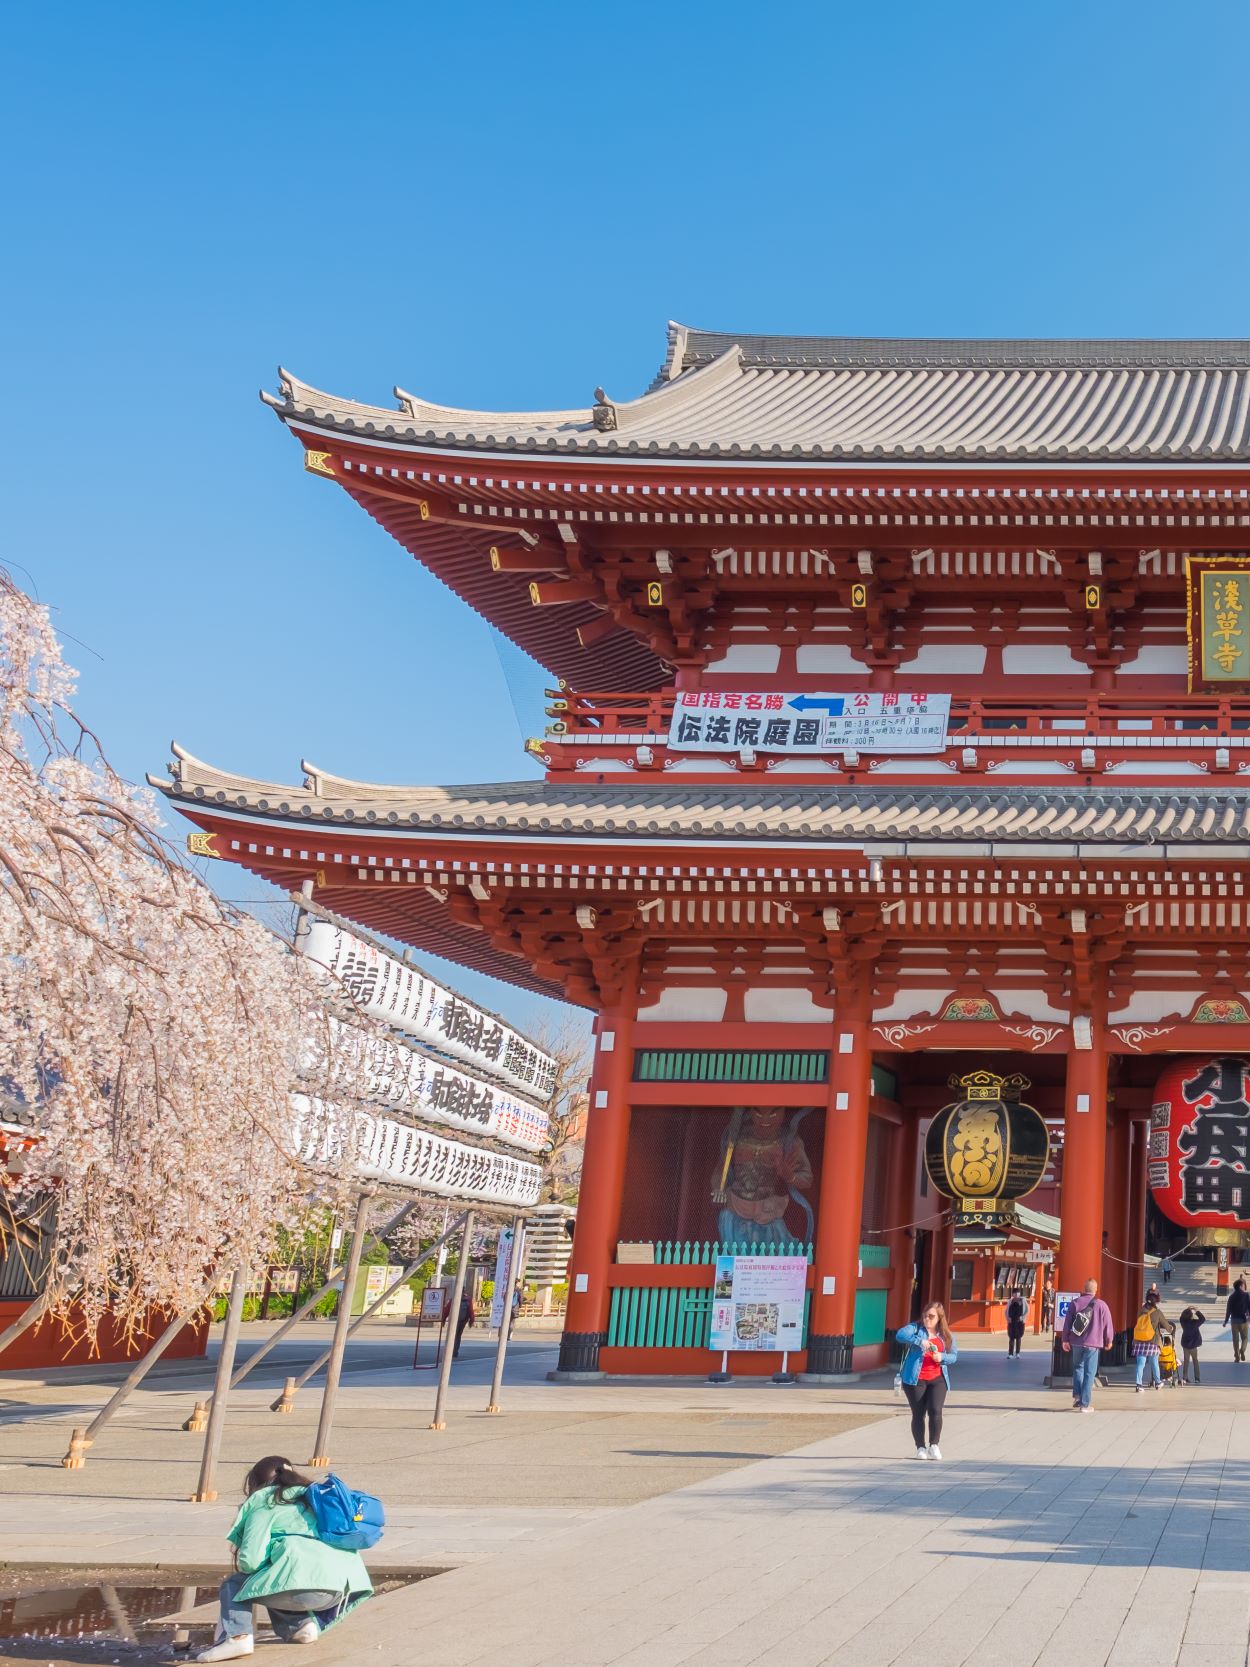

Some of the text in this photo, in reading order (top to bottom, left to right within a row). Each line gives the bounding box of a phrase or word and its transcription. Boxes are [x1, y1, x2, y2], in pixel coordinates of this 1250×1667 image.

[681, 693, 784, 711] 国指定名勝
[677, 713, 822, 746] 伝法院庭園
